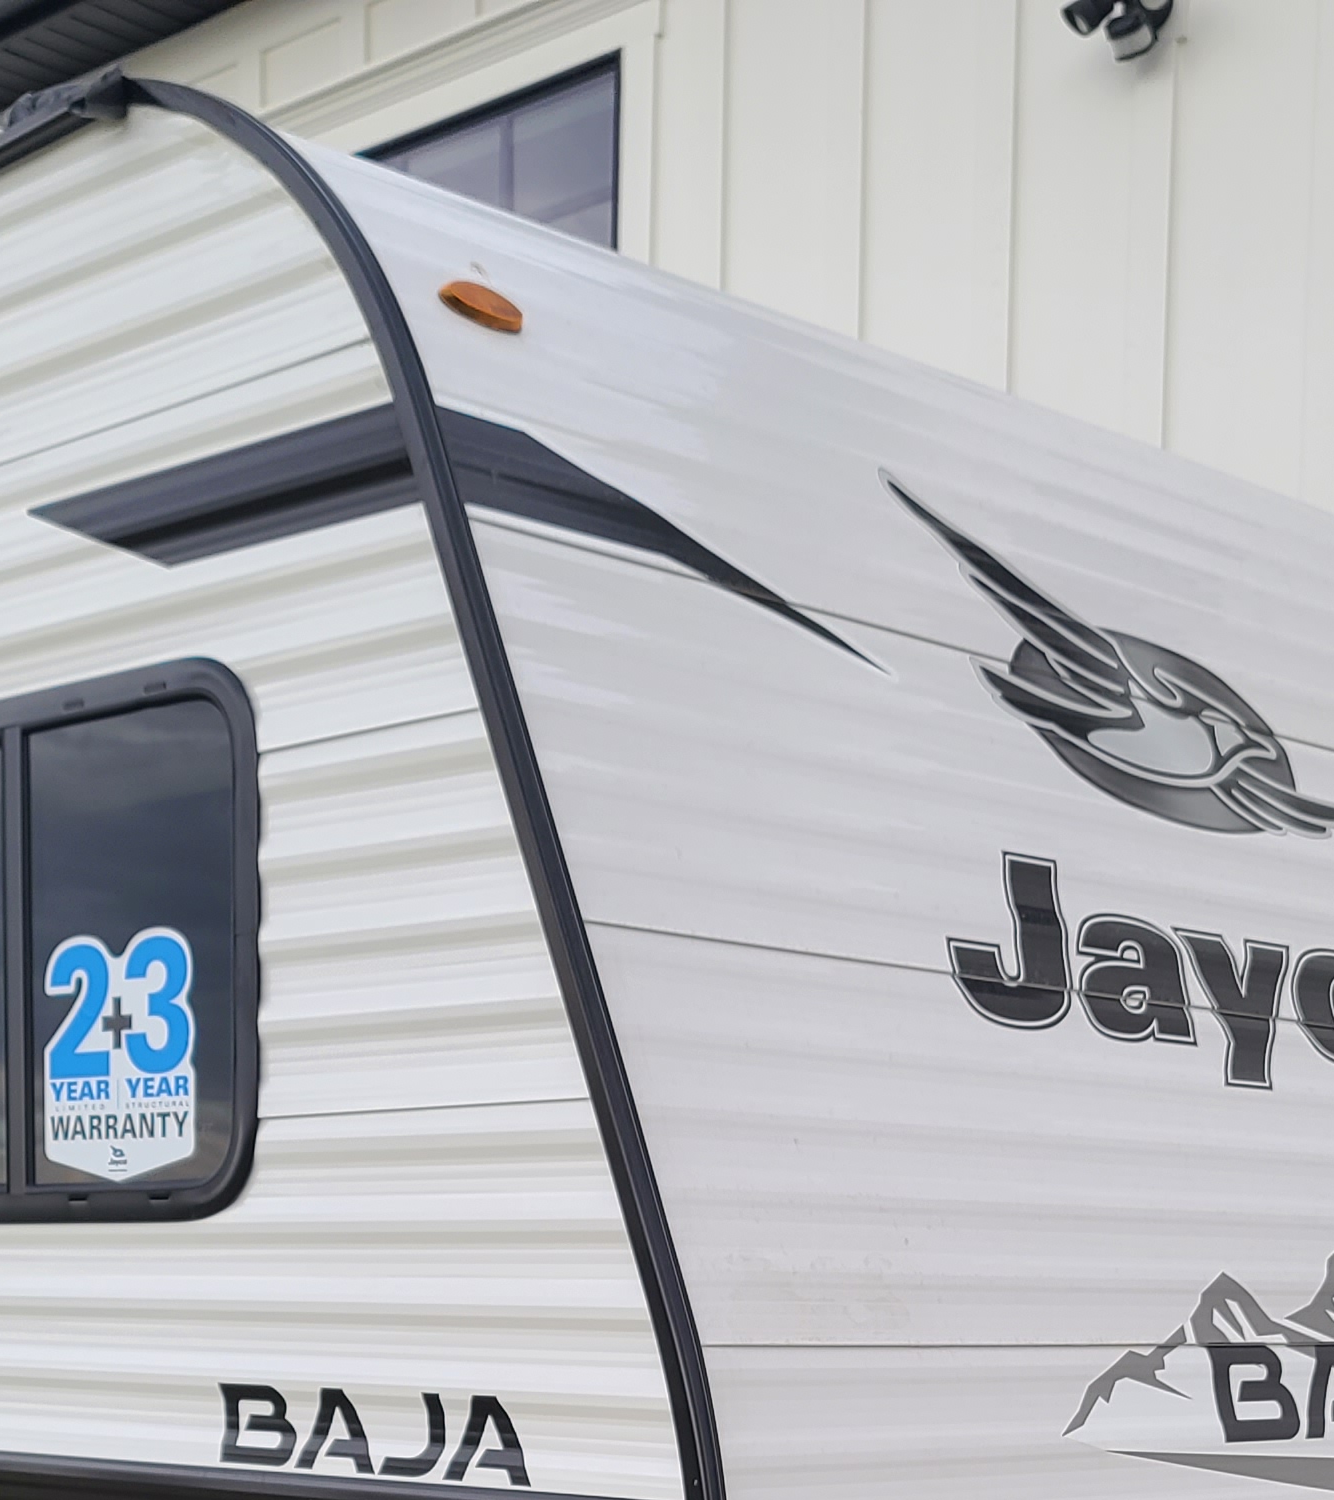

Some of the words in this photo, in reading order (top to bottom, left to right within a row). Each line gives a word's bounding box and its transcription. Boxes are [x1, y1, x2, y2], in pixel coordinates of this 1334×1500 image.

[50, 1080, 110, 1102] YEAR
[125, 1075, 189, 1099] YEAR
[55, 1104, 105, 1112] LIMITED
[125, 1101, 189, 1110] STRUCTURAL
[50, 1111, 189, 1141] WARRANTY
[218, 1382, 532, 1487] BAJA
